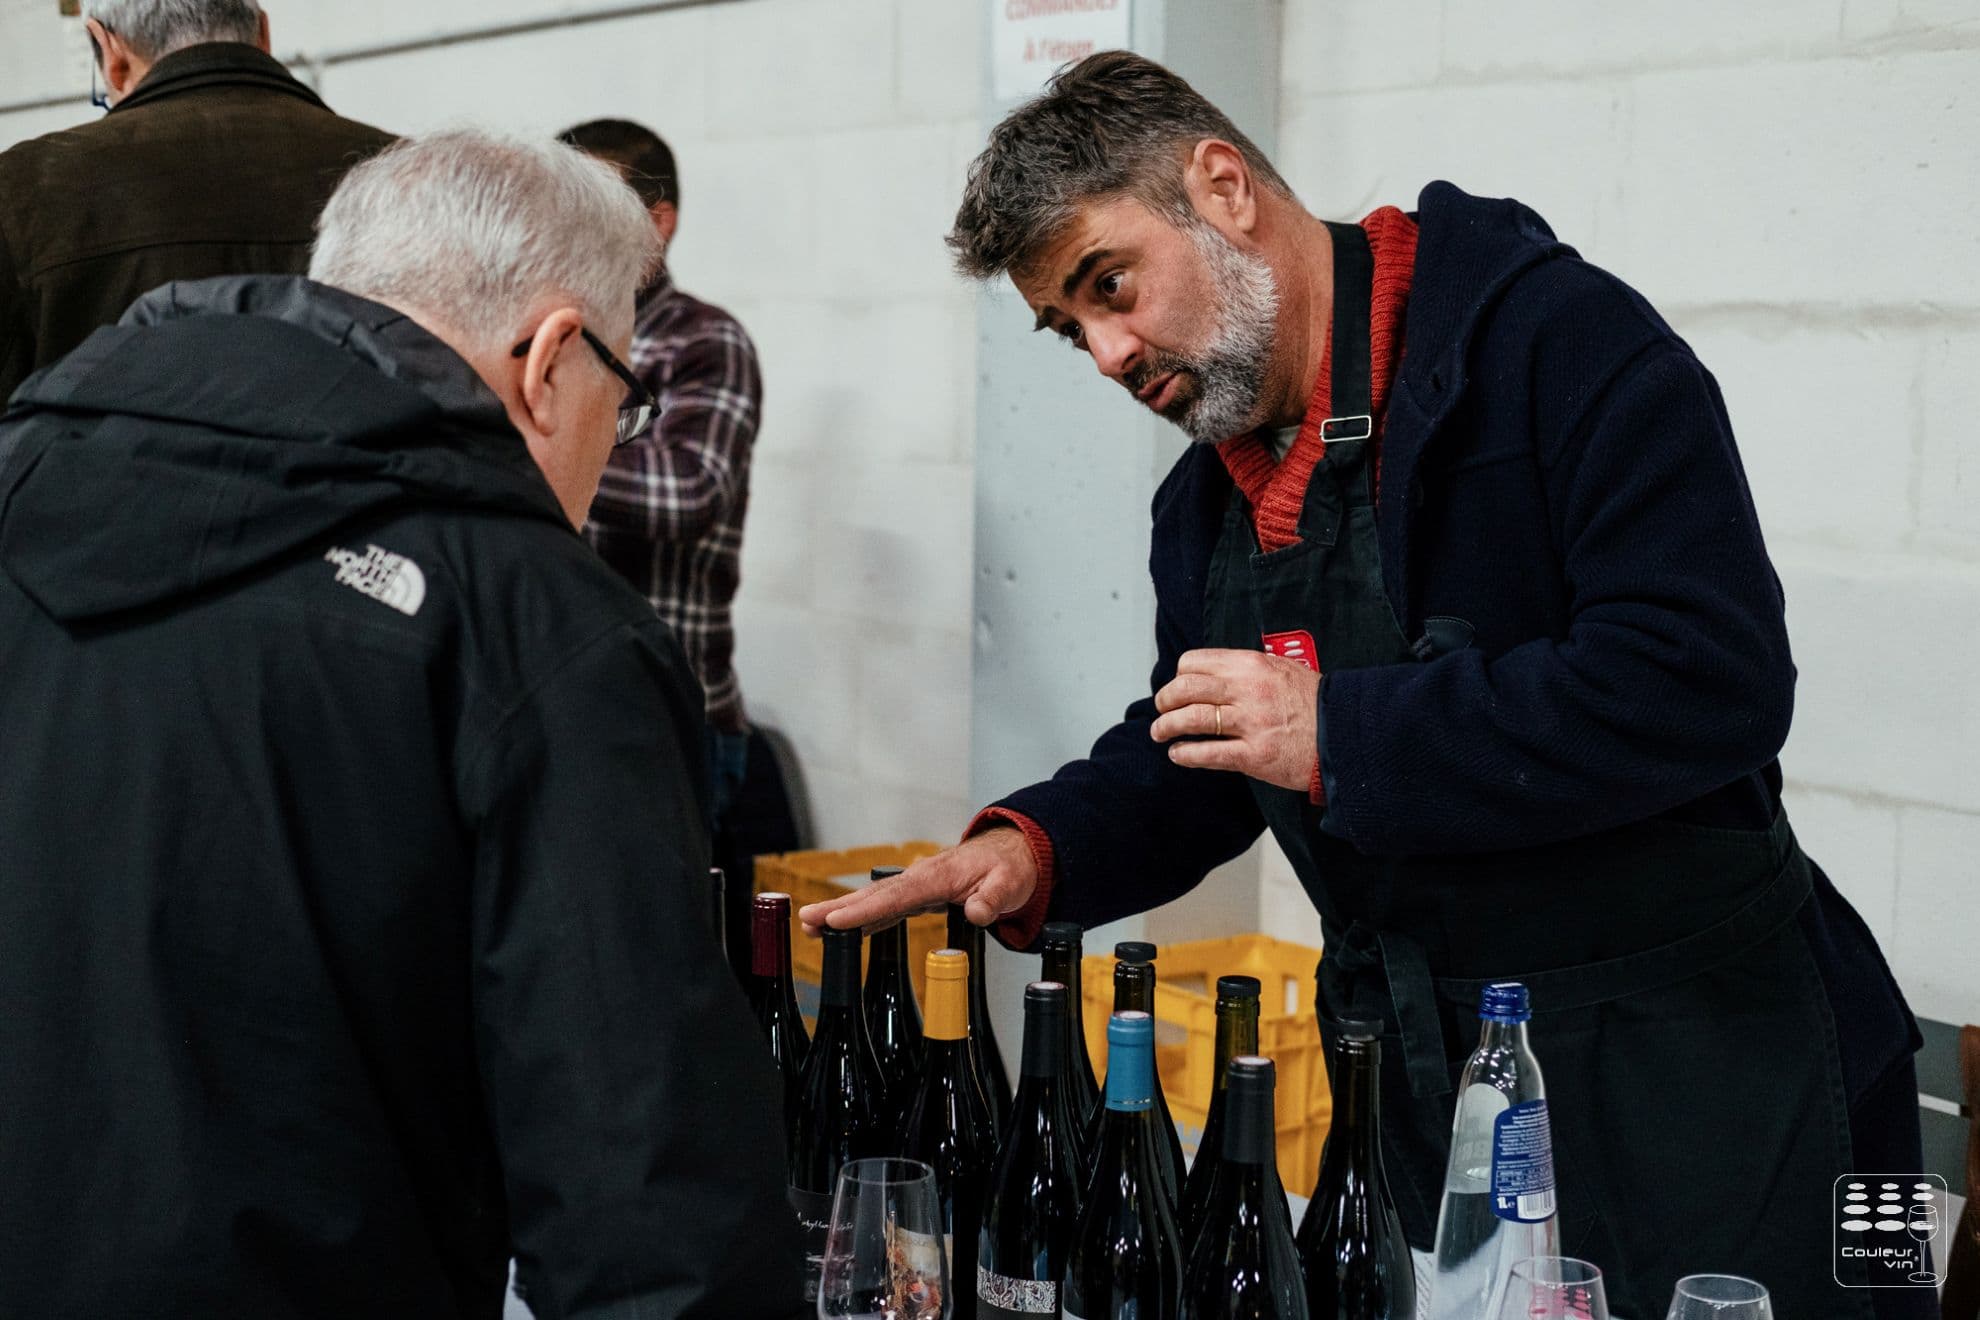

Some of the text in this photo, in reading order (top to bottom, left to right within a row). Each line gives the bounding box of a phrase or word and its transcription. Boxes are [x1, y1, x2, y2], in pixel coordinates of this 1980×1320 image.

[324, 548, 391, 588] NORTH
[365, 544, 401, 569] THE
[335, 566, 387, 602] FACE
